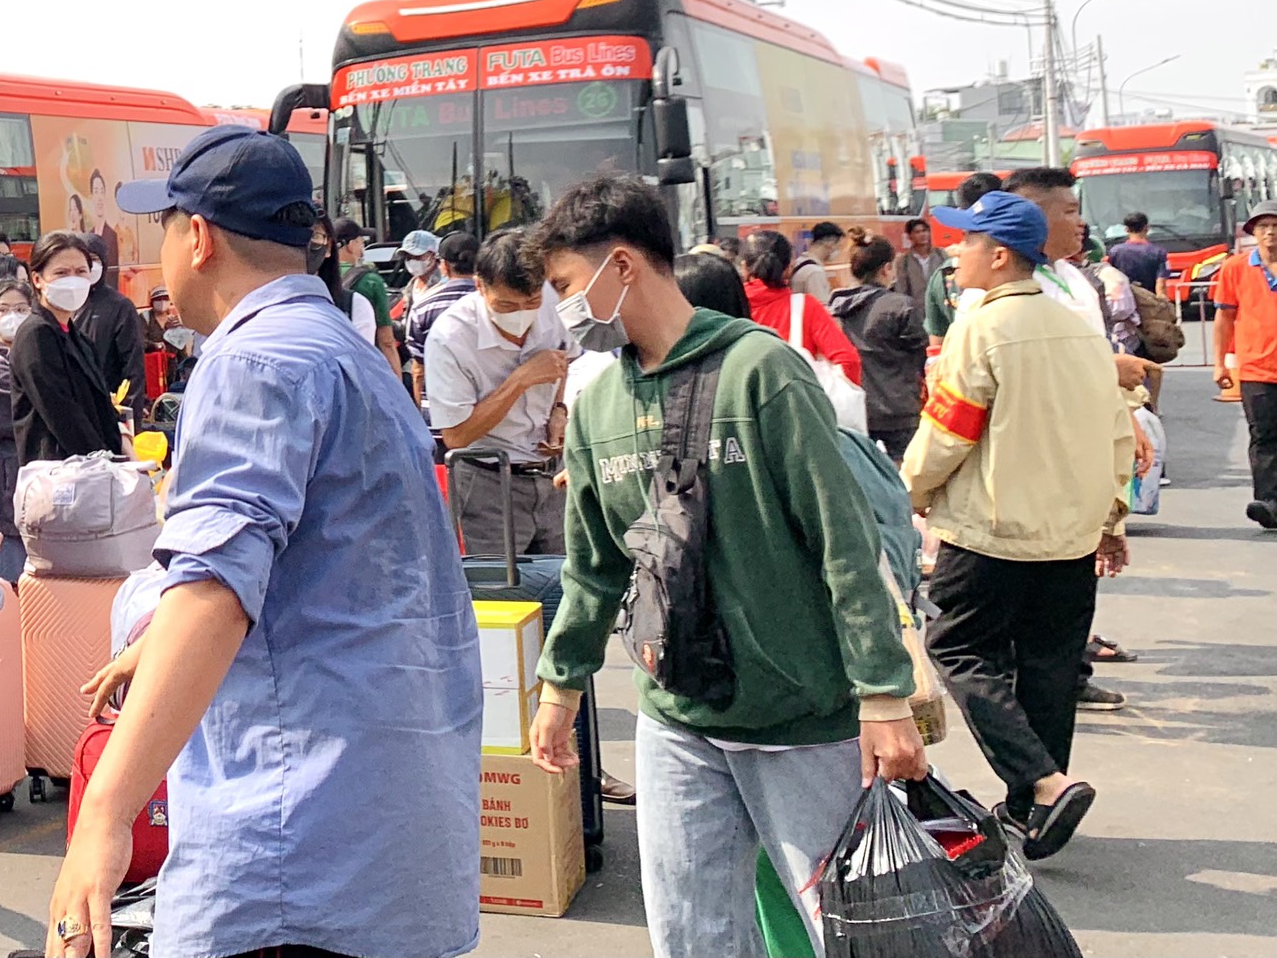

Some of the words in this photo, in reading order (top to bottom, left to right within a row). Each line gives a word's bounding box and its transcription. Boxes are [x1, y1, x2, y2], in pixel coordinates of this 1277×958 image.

[486, 47, 547, 72] FUTA
[550, 45, 584, 66] Bus
[587, 42, 636, 63] Lines
[410, 56, 469, 80] TRANG
[527, 70, 554, 83] XE
[369, 88, 391, 101] XE
[439, 102, 471, 124] Bu
[494, 95, 569, 120] Lines
[484, 772, 522, 786] MWG
[482, 796, 511, 812] BÁNH
[480, 815, 512, 829] OKIES
